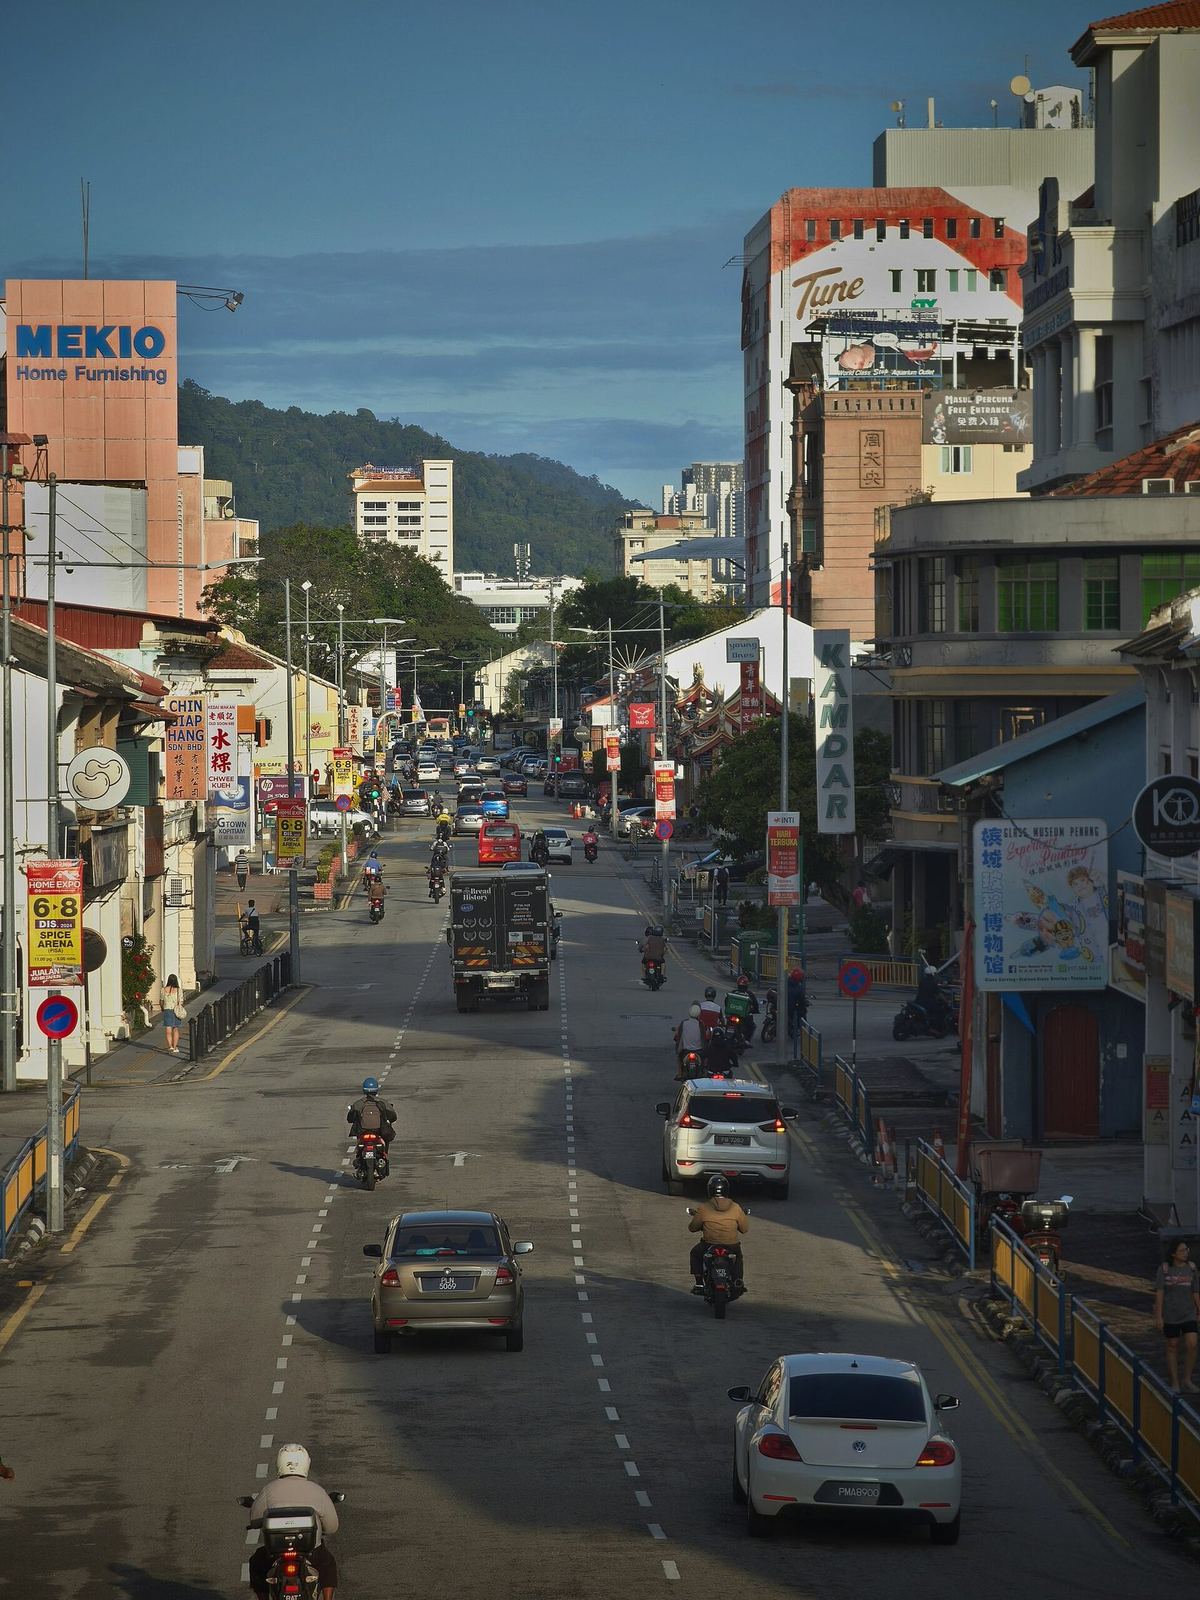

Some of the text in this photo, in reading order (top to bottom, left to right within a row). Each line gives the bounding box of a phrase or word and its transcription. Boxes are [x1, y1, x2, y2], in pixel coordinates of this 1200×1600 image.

[792, 267, 865, 320] Tune
[16, 324, 166, 359] MEKIO
[16, 365, 167, 385] Home Furnishing
[957, 416, 999, 426] 免费入场
[169, 700, 203, 712] CHIN
[168, 729, 204, 742] HANG
[820, 643, 850, 819] KAMDAR
[262, 780, 273, 791] hp
[281, 819, 304, 831] 6 8
[782, 816, 795, 824] INTI
[777, 830, 792, 838] HARI
[1033, 827, 1065, 837] MUSEUM
[1070, 826, 1100, 837] PENANG
[770, 838, 798, 847] TERBUKA
[29, 880, 80, 889] HOME EXPO
[471, 887, 492, 895] Bread
[463, 894, 488, 902] History
[34, 897, 78, 918] 6 8
[39, 920, 59, 928] DIS.
[40, 931, 71, 939] SPICE
[38, 940, 74, 948] ARENA
[30, 967, 61, 977] JUALAN
